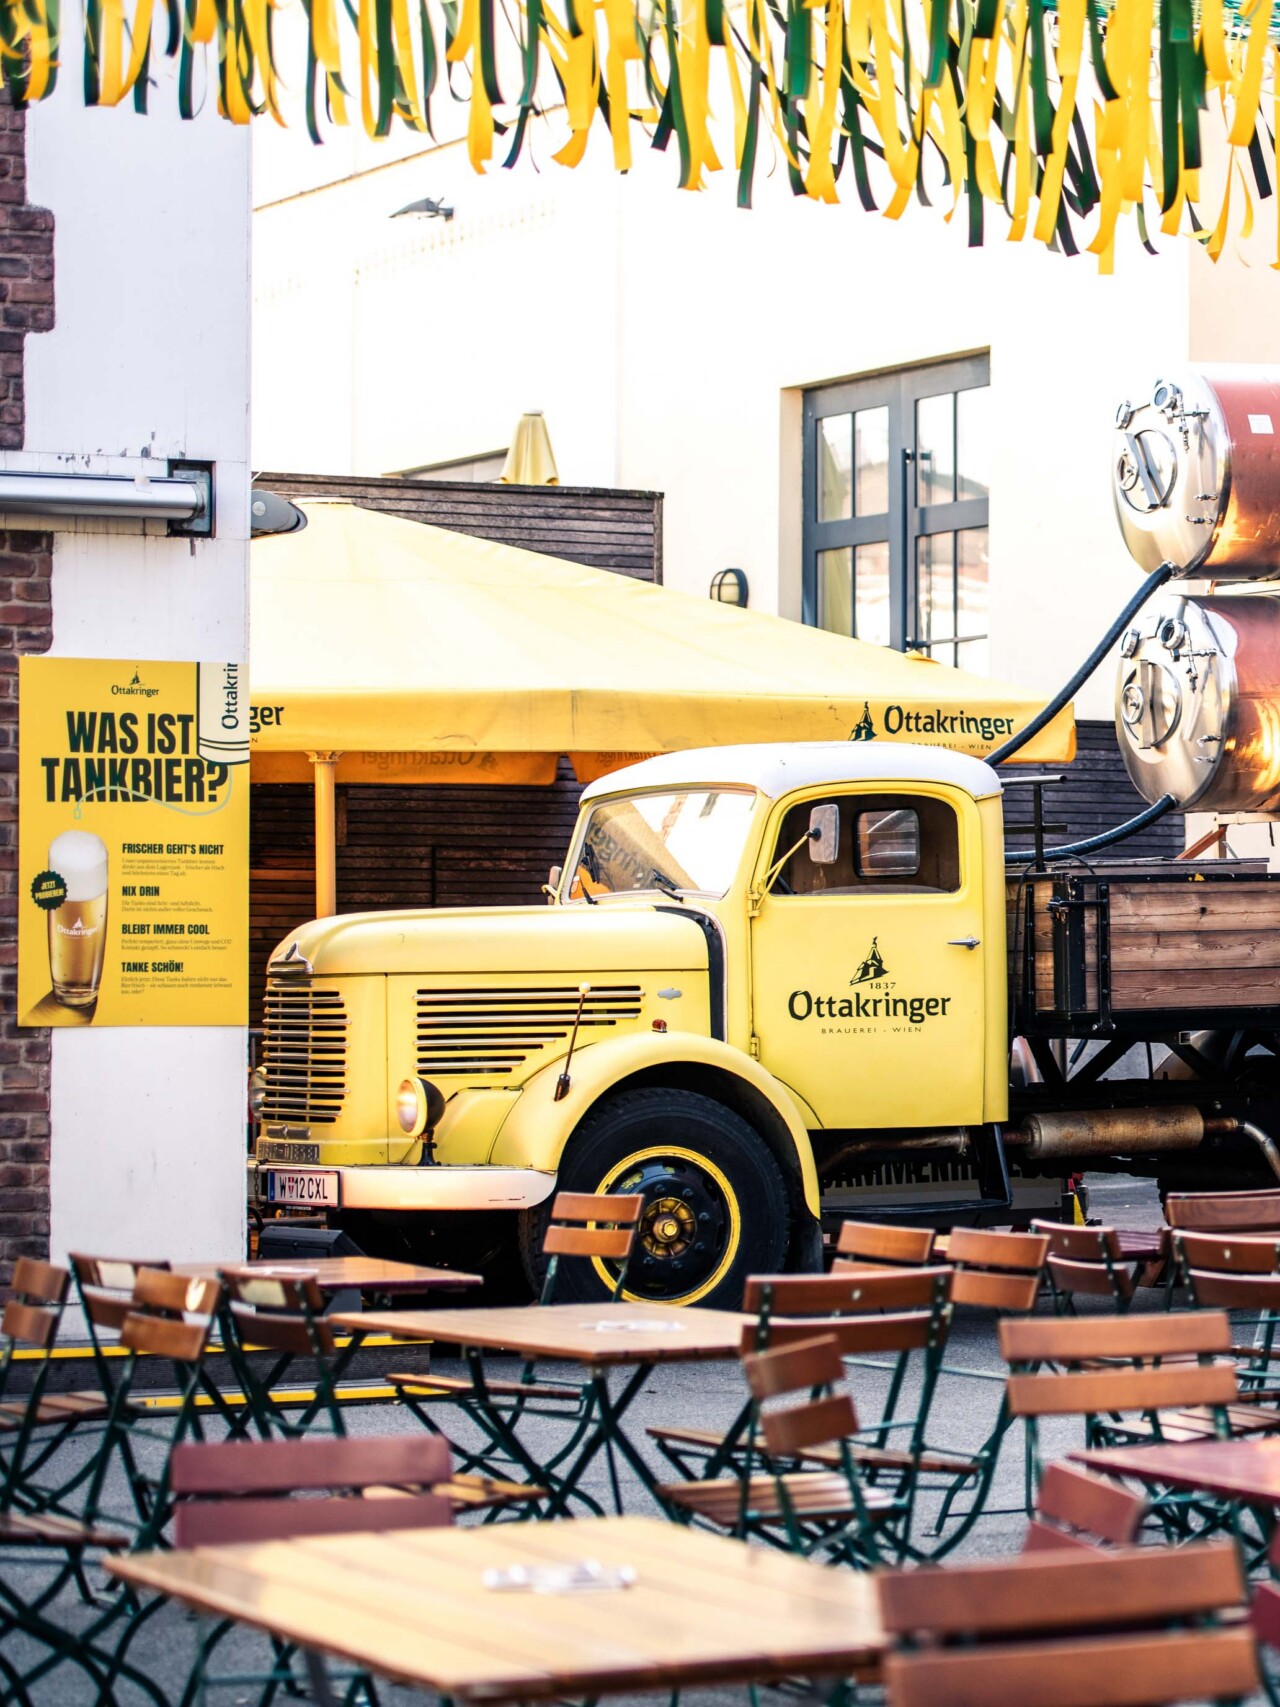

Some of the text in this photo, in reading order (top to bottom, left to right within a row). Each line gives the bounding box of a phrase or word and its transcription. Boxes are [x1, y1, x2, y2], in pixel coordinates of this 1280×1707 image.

[111, 685, 160, 697] Ottakringer
[884, 705, 1014, 741] Ottakringer
[66, 711, 194, 755] WAS IST
[41, 758, 229, 802] TANKBIER?
[121, 843, 224, 855] FRISCHER GEHT'S NICHT
[121, 885, 160, 896] NIX DRIN
[121, 923, 210, 935] BLEIBT IMMER COOL
[121, 959, 184, 973] TANKE SCHÖN!
[788, 990, 952, 1024] Ottakringer
[280, 1176, 328, 1200] W 12 CXL
